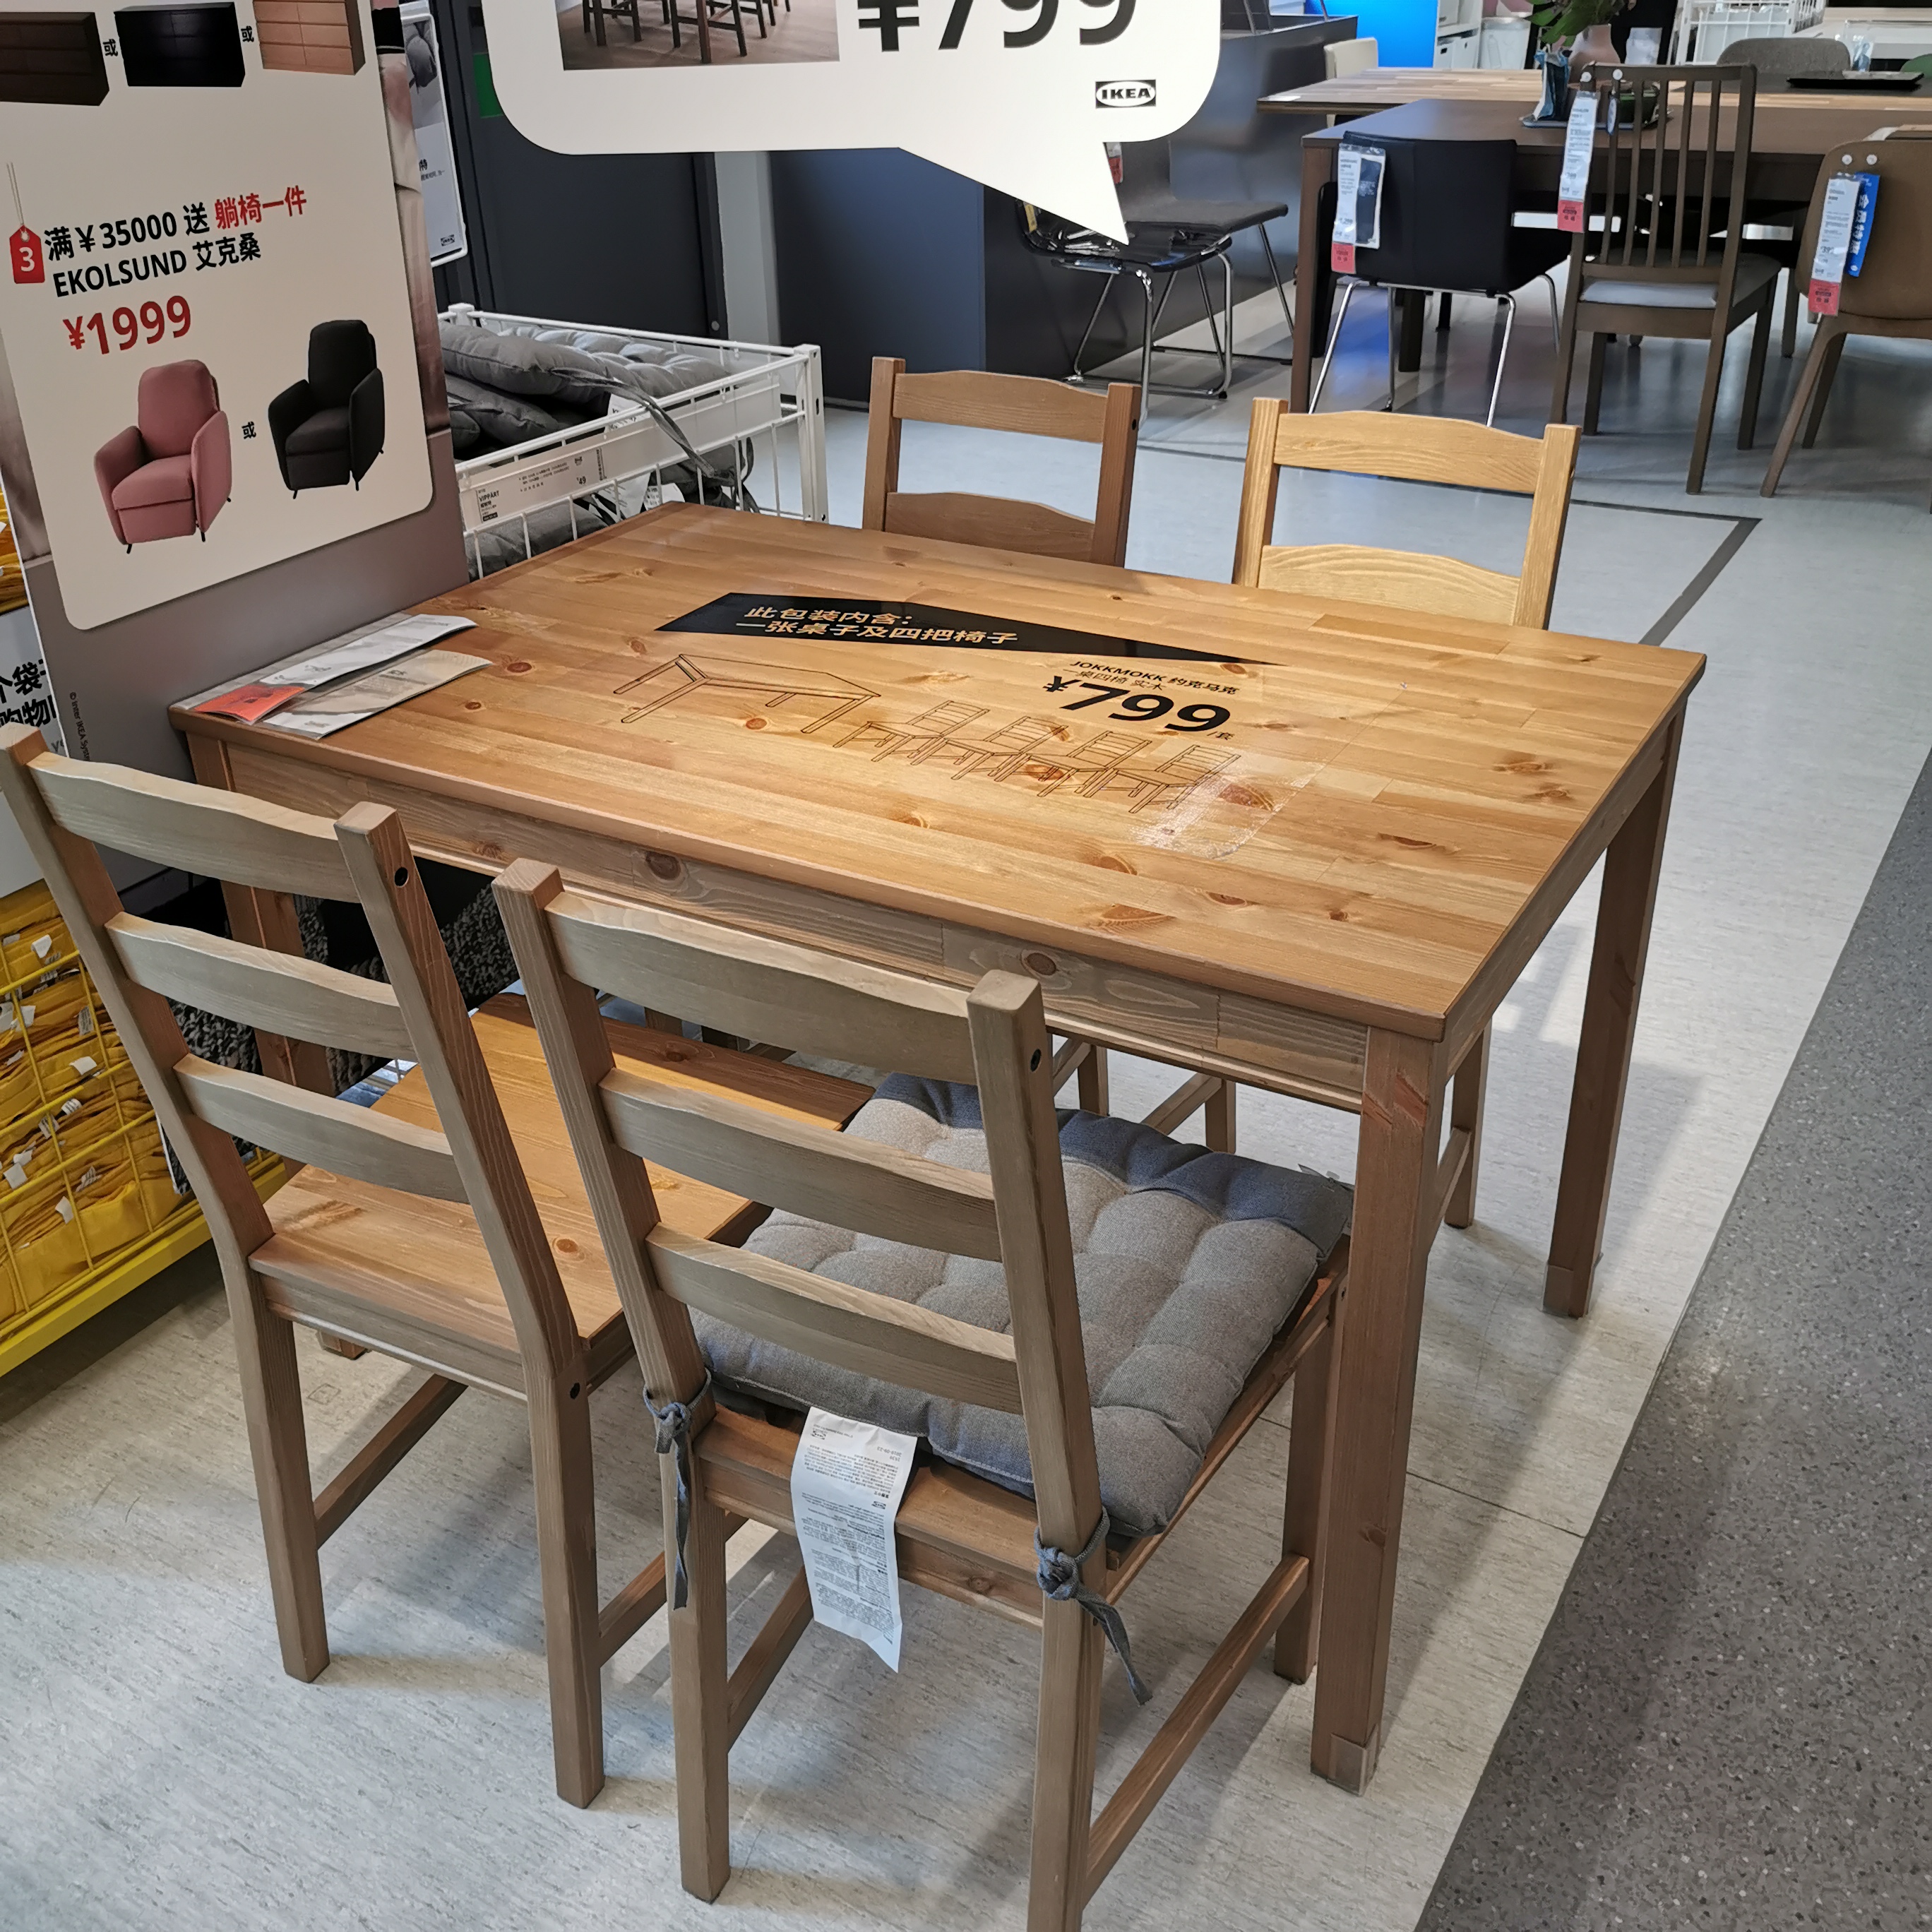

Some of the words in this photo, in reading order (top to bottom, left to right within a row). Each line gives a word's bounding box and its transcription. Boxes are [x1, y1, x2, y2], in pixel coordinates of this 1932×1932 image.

[241, 25, 254, 42] 或
[102, 39, 118, 56] 或
[183, 202, 210, 235] 送
[214, 185, 307, 229] 躺椅一件
[19, 247, 35, 271] 3
[53, 250, 187, 297] EKOLSUND
[193, 232, 261, 271] 艾克桑
[63, 296, 191, 354] ¥1999
[242, 421, 256, 439] 或
[744, 607, 913, 625] 此包装内含:
[736, 621, 1018, 645] 一张桌子及四把椅子
[1063, 669, 1130, 684] 一桌四椅
[1131, 680, 1167, 691] 实木
[1070, 661, 1167, 681] JOKKMOKK
[1167, 677, 1239, 695] 约克马克
[1042, 676, 1230, 732] ¥799
[76, 720, 86, 740] IKEA
